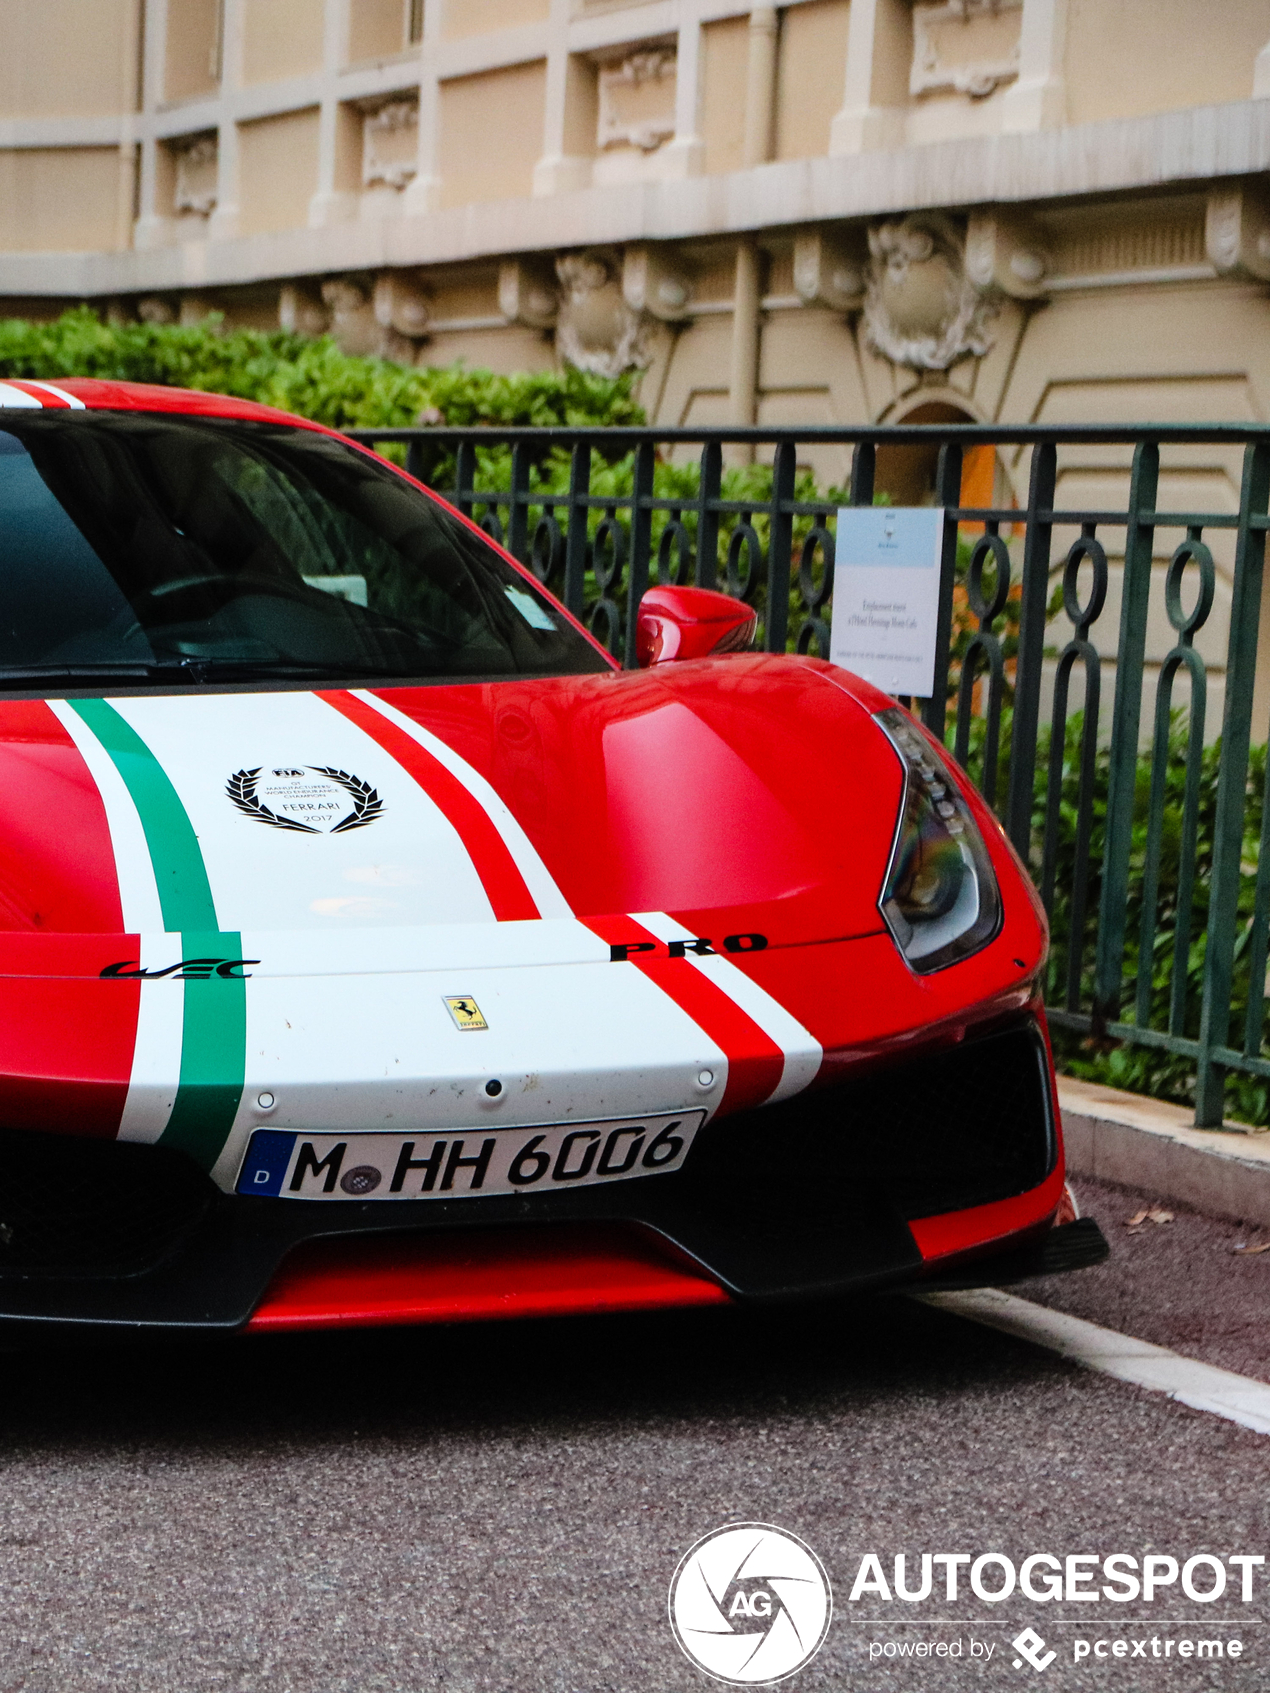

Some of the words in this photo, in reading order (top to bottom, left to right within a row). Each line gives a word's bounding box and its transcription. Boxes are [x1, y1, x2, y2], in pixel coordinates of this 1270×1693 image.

[282, 803, 340, 811] FERRARI
[610, 933, 769, 962] PRO
[99, 958, 261, 979] WEC
[289, 1142, 347, 1192] M
[389, 1139, 497, 1192] HH
[507, 1121, 684, 1185] 6006
[253, 1170, 270, 1184] D
